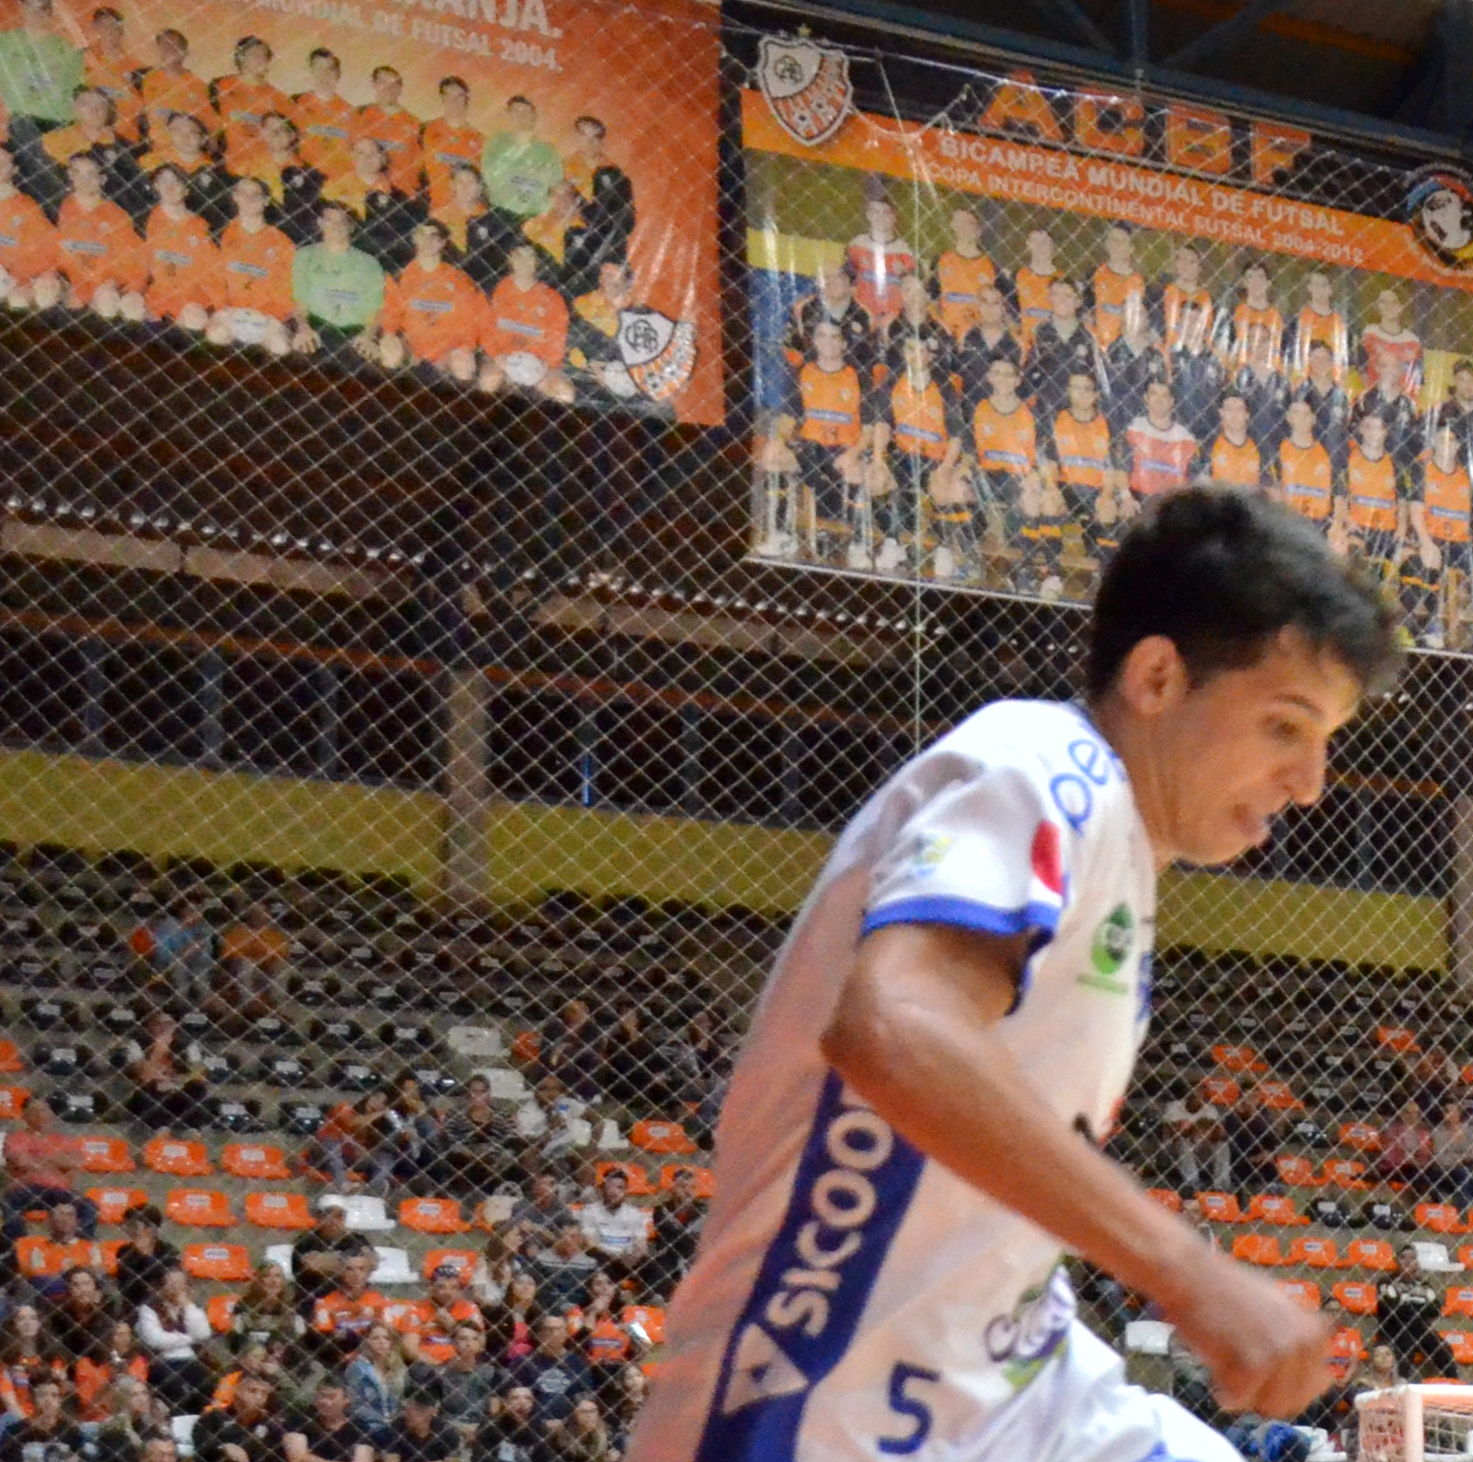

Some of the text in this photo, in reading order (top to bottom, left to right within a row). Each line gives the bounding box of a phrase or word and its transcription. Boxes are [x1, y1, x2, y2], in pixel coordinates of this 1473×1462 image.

[410, 17, 494, 58] FUTSAL
[977, 66, 1312, 186] ACBF
[927, 161, 983, 188] COPA
[986, 174, 1189, 228] INTERCONTINENTAL
[1193, 216, 1267, 244] FUTSAL
[1086, 164, 1204, 208] MUNDIAL
[1211, 190, 1246, 215] DE
[1250, 199, 1345, 237] FUTSAL
[876, 1361, 942, 1456] 5
